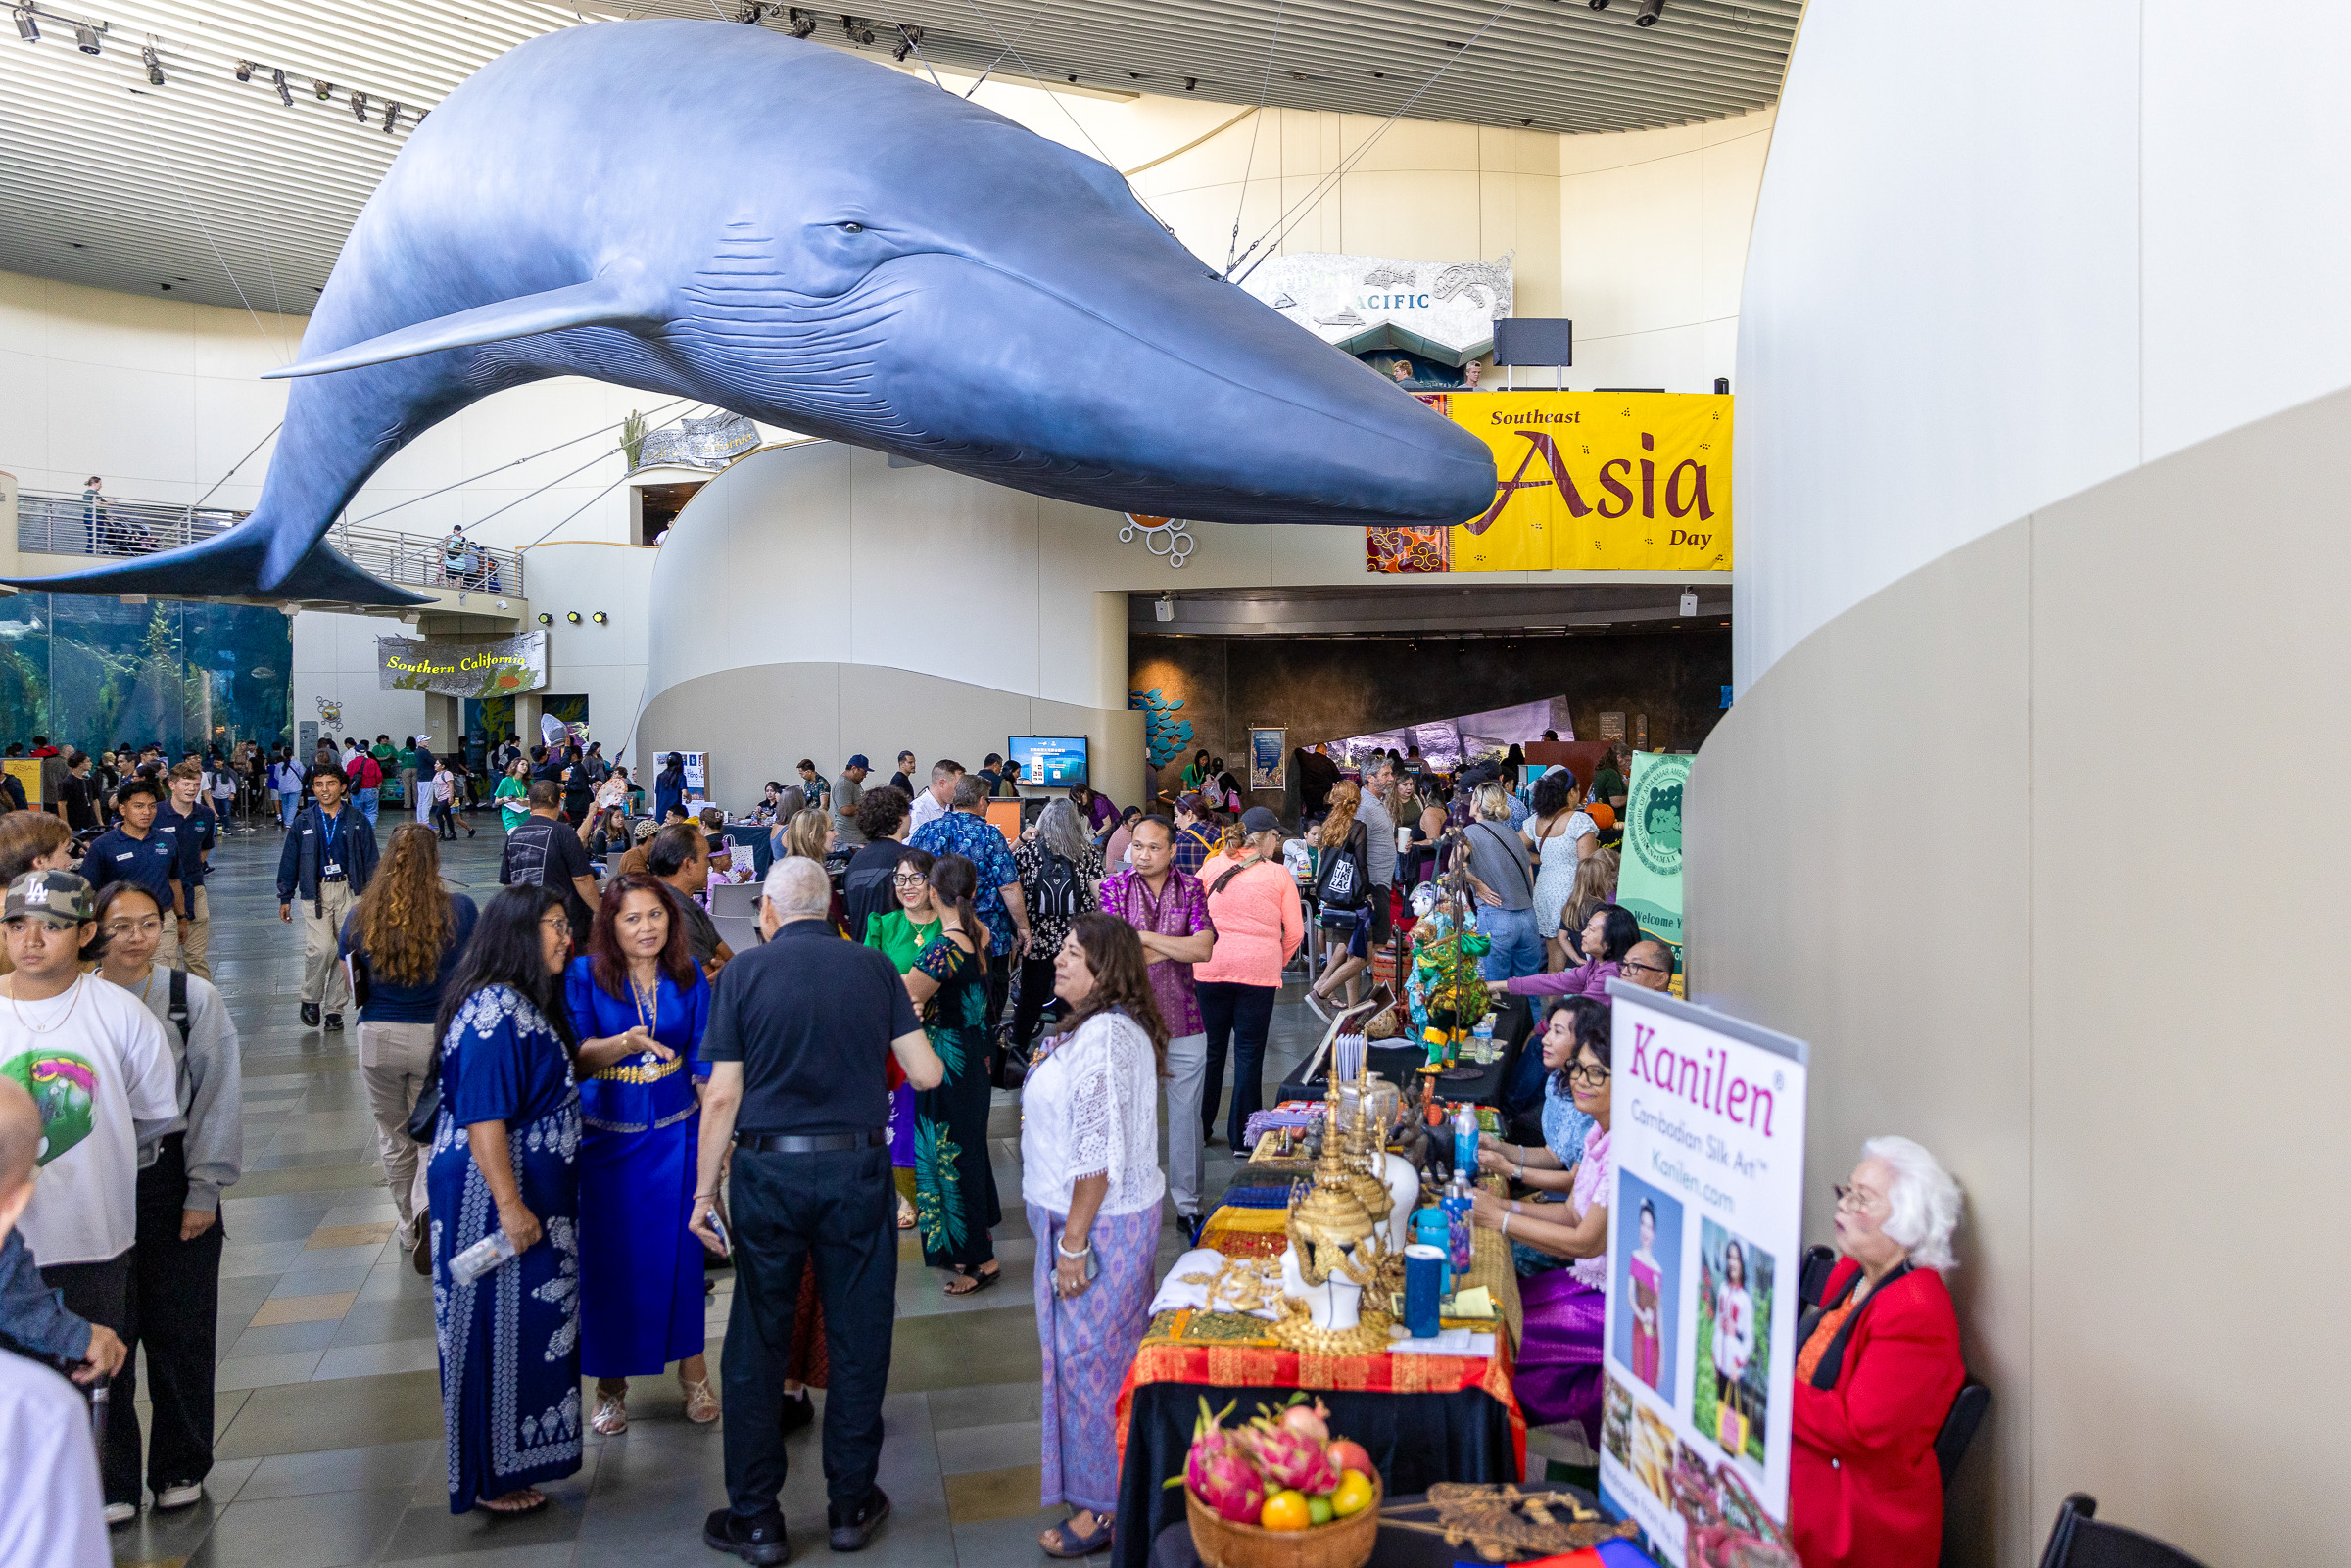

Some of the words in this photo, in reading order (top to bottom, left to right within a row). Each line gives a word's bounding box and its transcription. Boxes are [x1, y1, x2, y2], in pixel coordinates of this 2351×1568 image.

[1344, 294, 1430, 309] ACIFIC
[1491, 409, 1581, 426] Southeast
[694, 433, 752, 451] California
[1463, 431, 1715, 536] Asia
[1669, 529, 1712, 550] Day
[386, 655, 455, 674] Southern
[460, 651, 526, 671] California
[1639, 794, 1646, 806] OF
[1644, 768, 1669, 794] MYANMAR
[1648, 848, 1676, 863] NetMAA
[26, 878, 48, 904] LA
[1634, 910, 1674, 927] Welcome
[1631, 1098, 1703, 1152] Cambodian
[1705, 1134, 1729, 1168] Silk
[1652, 1148, 1735, 1213] Kanilen.com
